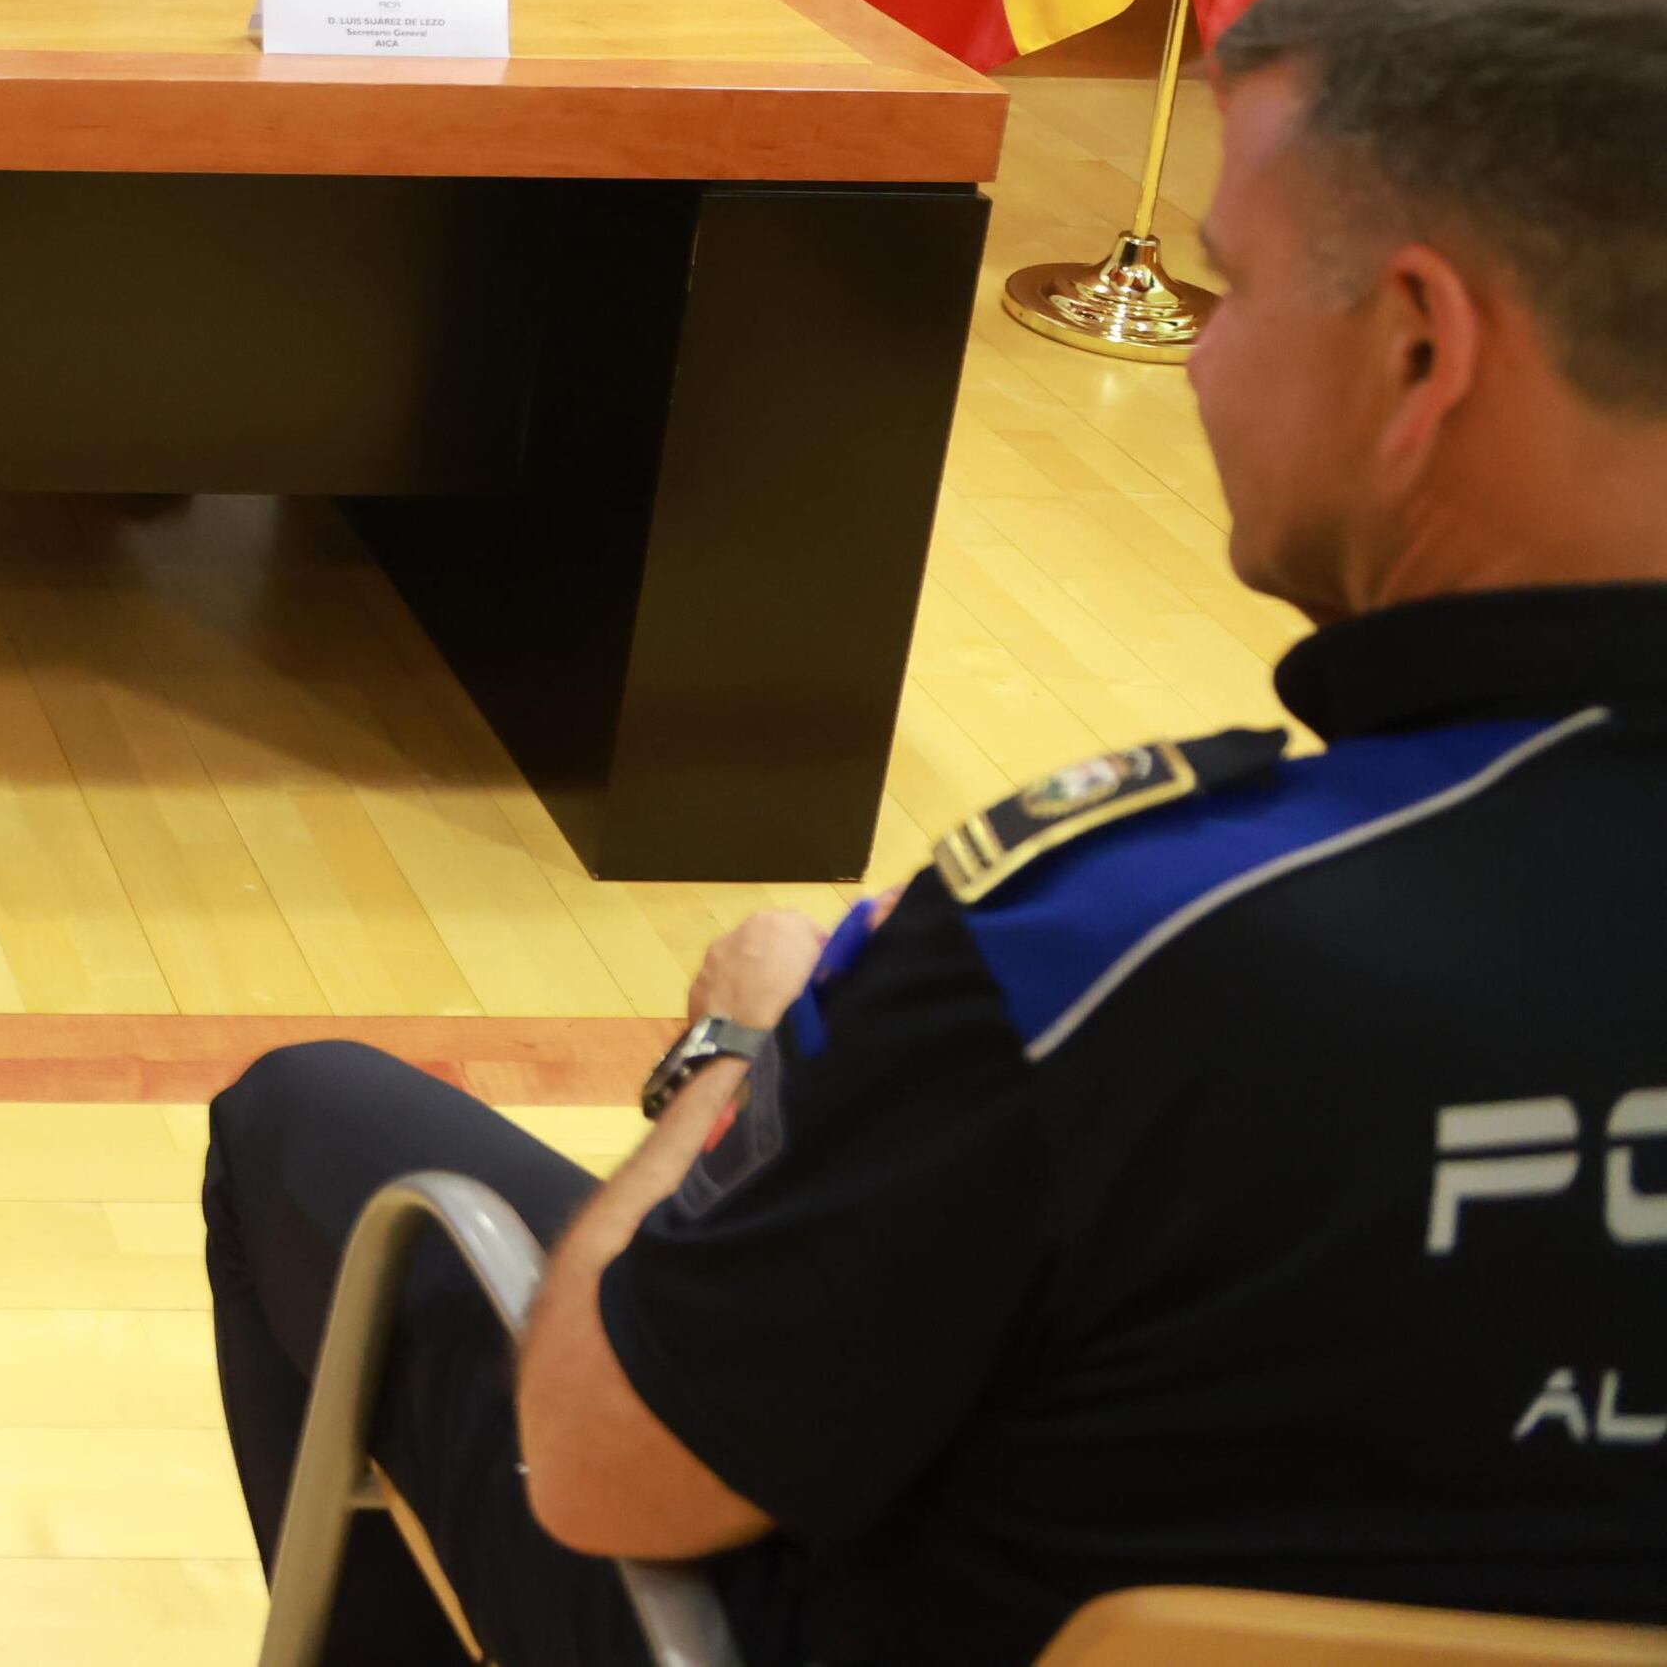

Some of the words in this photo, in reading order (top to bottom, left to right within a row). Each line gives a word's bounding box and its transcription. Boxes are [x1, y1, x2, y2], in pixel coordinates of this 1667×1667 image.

[340, 17, 362, 26] LUIS
[364, 16, 402, 26] SUÁREZ
[404, 18, 417, 26] DE
[420, 18, 446, 27] LEZO
[346, 28, 392, 37] Secretario
[393, 29, 428, 37] General
[375, 40, 399, 48] AICA
